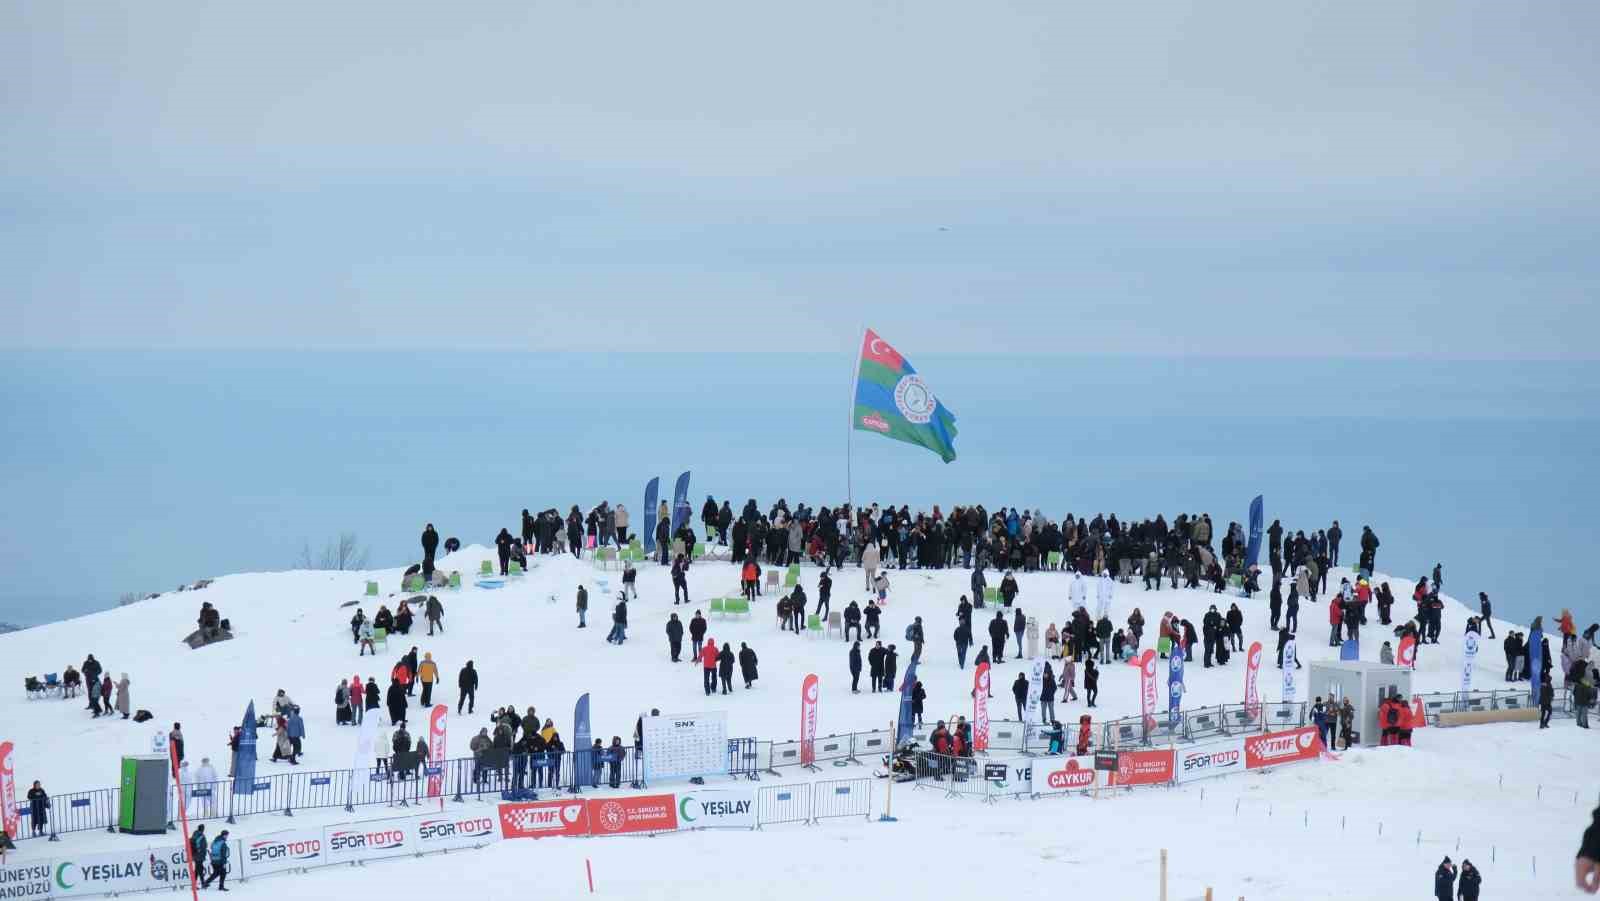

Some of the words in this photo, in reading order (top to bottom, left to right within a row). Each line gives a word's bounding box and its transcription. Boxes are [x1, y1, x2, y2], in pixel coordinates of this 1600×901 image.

[675, 720, 696, 728] SNX
[528, 811, 558, 824] TMF
[0, 865, 50, 884] ÜNEYSU
[0, 879, 50, 899] ANDÜZÜ
